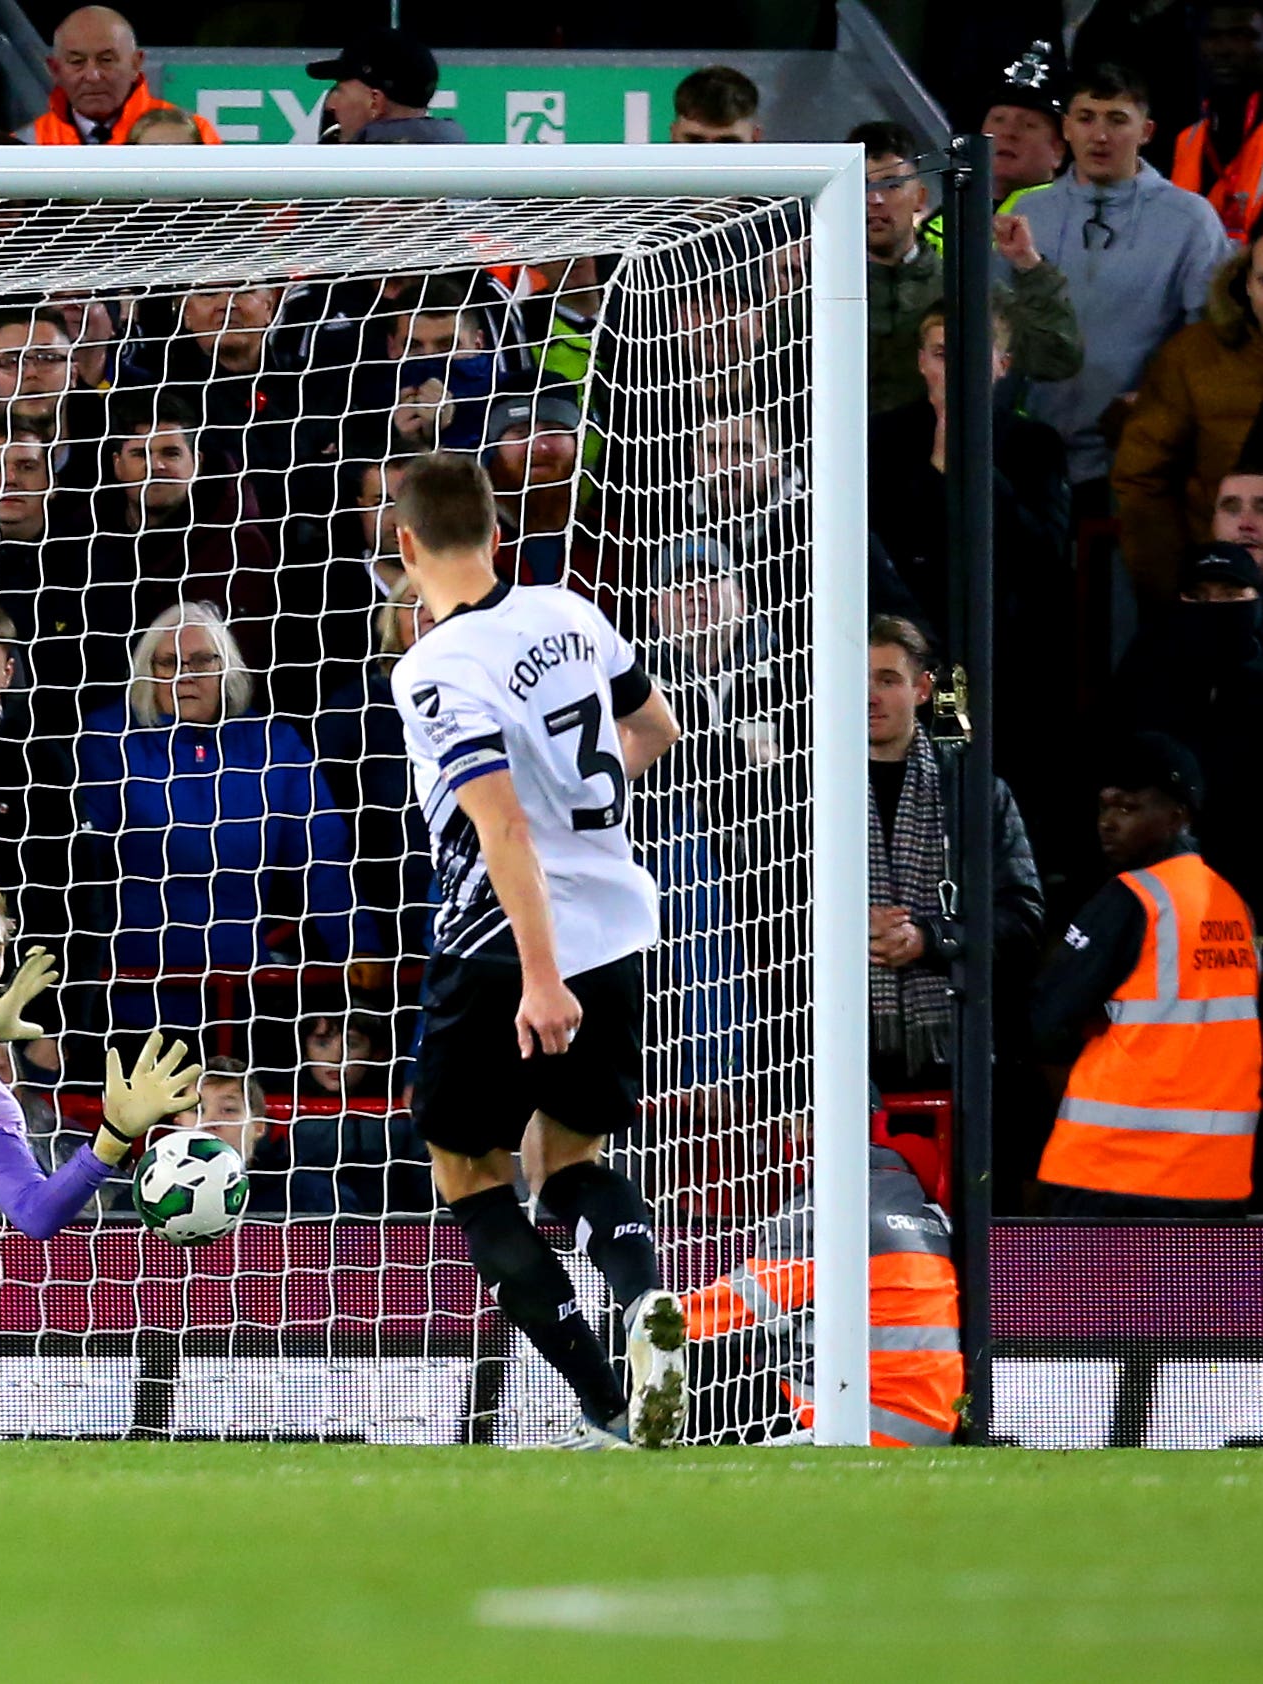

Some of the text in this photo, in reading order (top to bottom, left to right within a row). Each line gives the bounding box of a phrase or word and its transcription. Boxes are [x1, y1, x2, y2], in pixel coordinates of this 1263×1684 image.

[508, 631, 595, 703] FORSYTH
[542, 691, 626, 831] 3
[1199, 919, 1245, 942] CROWD
